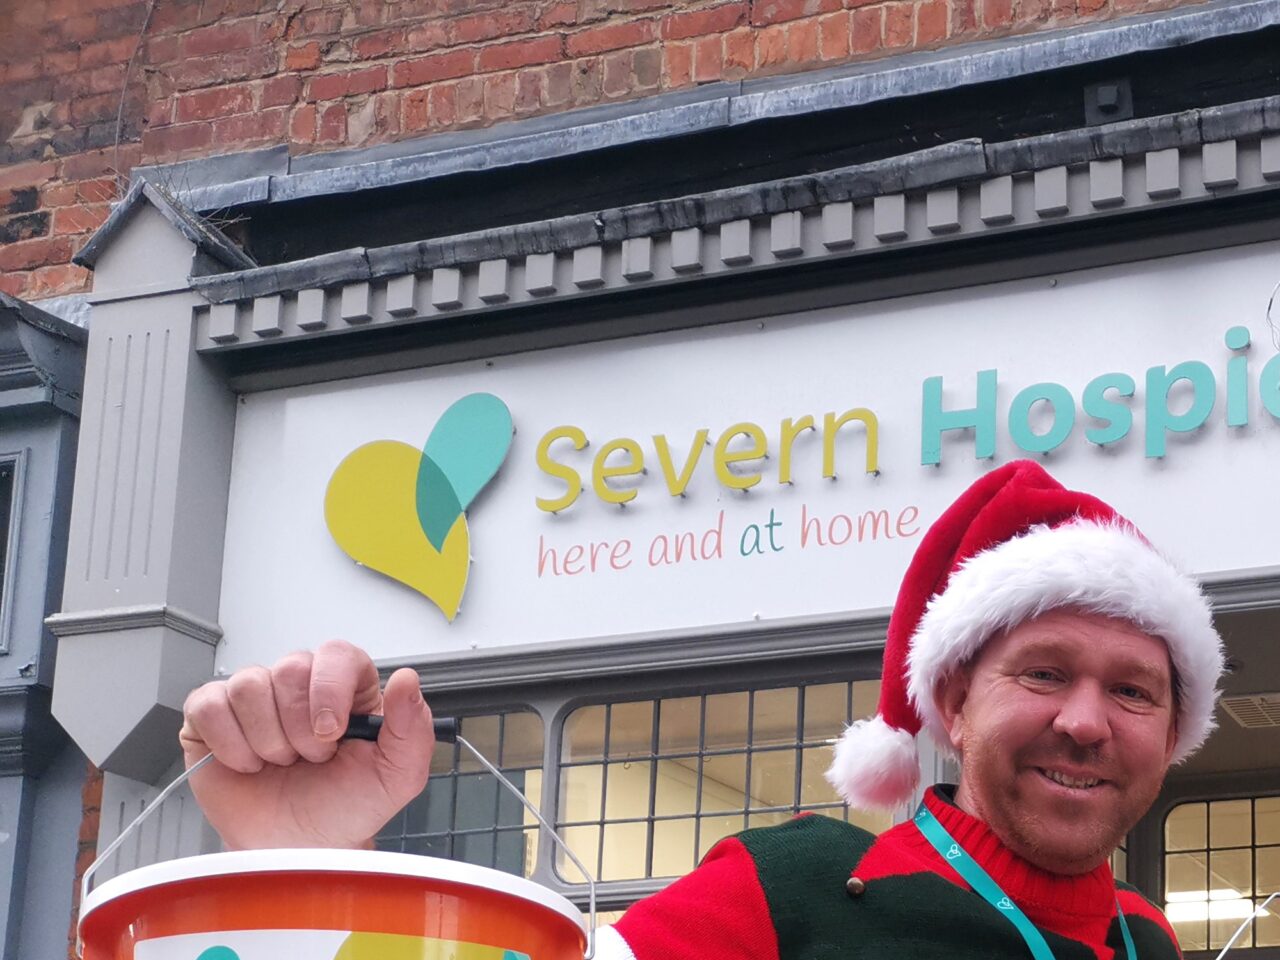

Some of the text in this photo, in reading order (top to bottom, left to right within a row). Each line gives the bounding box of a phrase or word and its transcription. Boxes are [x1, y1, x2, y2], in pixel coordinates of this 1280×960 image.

[535, 407, 880, 513] Severn
[536, 502, 920, 578] here and at home
